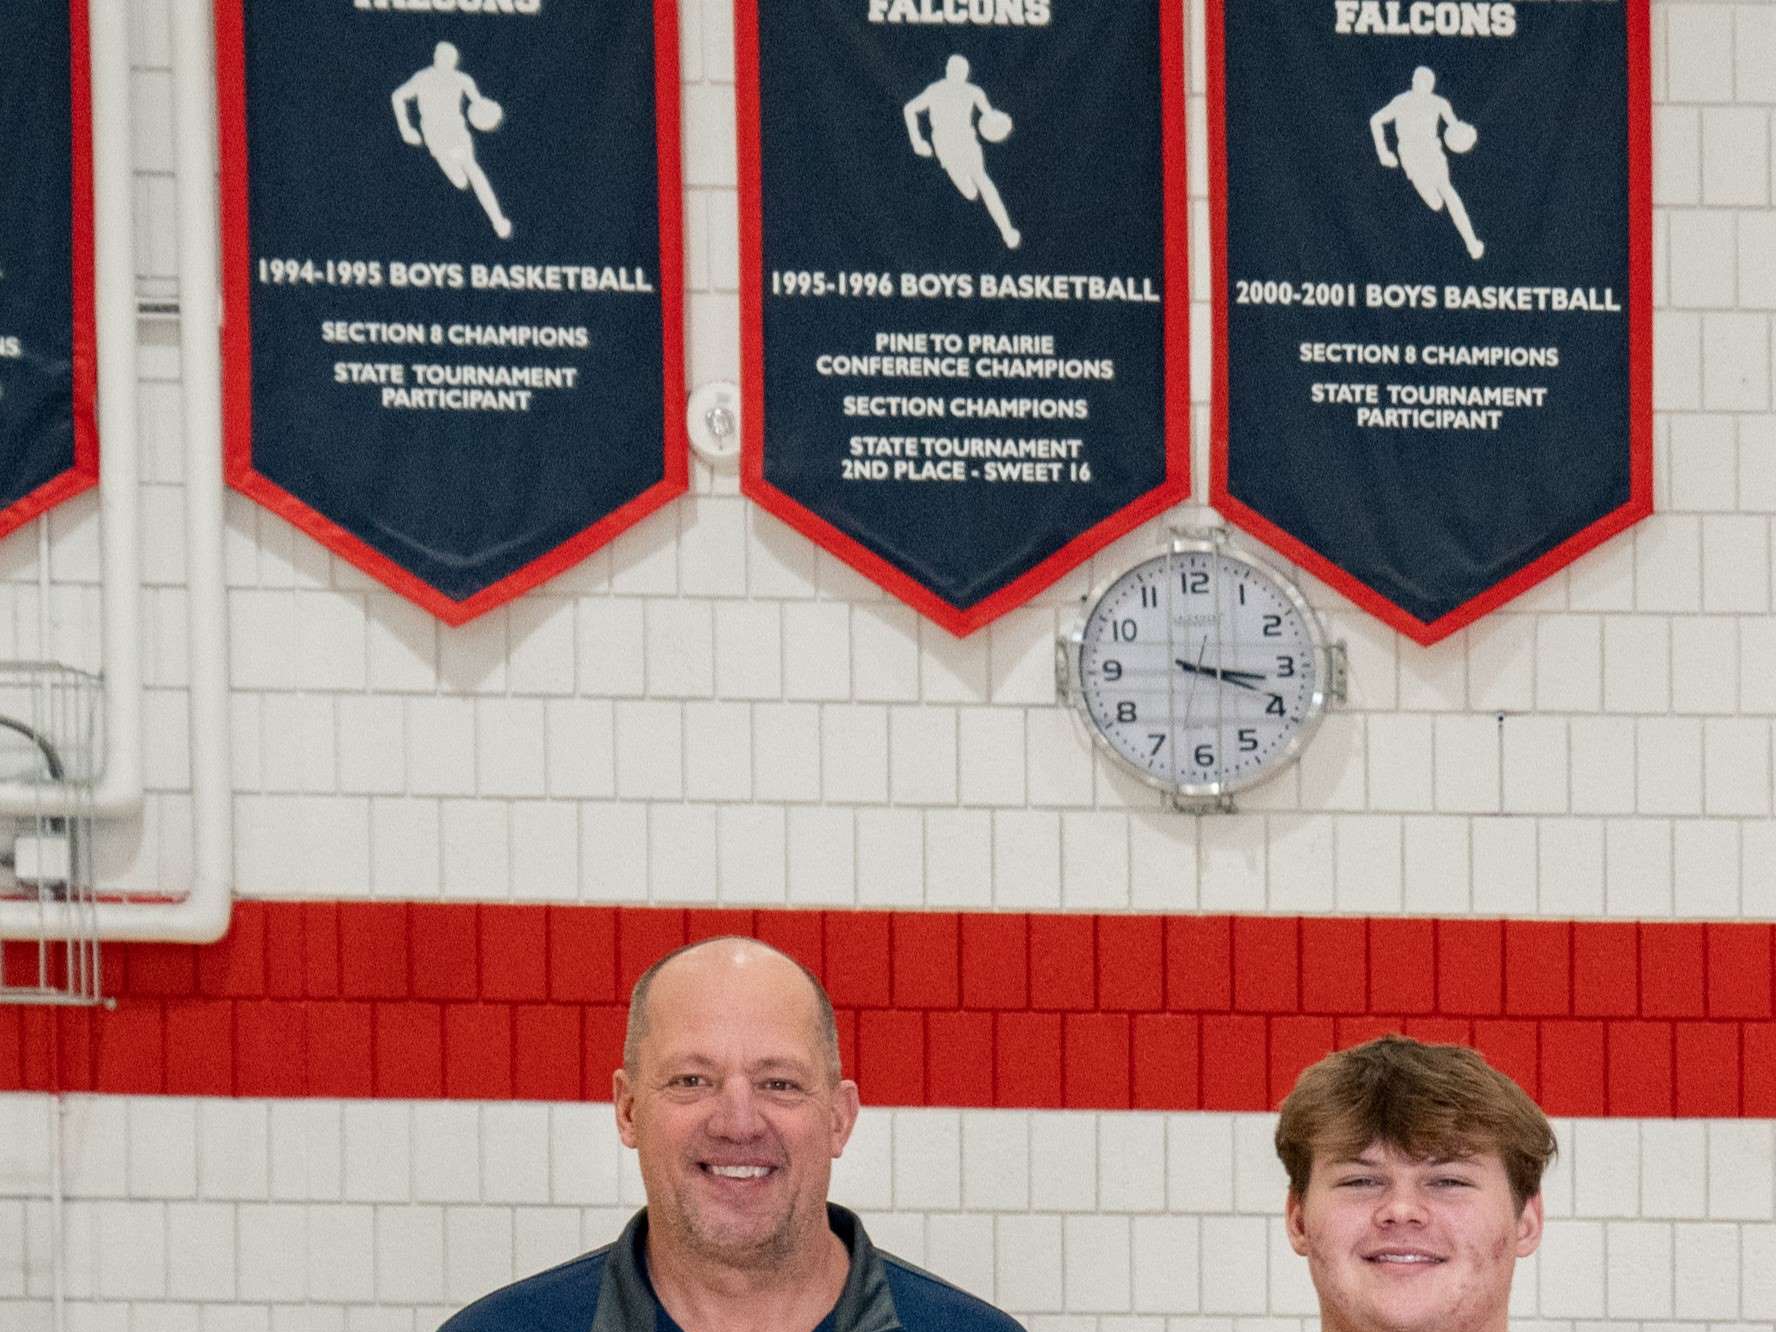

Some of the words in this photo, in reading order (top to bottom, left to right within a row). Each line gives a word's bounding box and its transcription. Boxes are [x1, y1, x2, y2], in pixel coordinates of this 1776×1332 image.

[867, 0, 1051, 25] FALCONS
[1334, 0, 1517, 37] FALCONS
[257, 259, 383, 286] 1994-1995
[388, 261, 464, 289] BOYS
[469, 264, 654, 294] BASKETBALL
[770, 271, 894, 298] 1995-1996
[900, 273, 974, 299] BOYS
[980, 274, 1160, 303] BASKETBALL
[1235, 281, 1359, 308] 2000-2001
[1365, 283, 1439, 309] BOYS
[1443, 285, 1622, 313] BASKETBALL
[321, 322, 423, 345] SECTION
[427, 324, 443, 345] 8
[446, 325, 589, 349] CHAMPIONS
[874, 333, 924, 355] PINE
[922, 333, 961, 355] TO
[967, 333, 1055, 356] PRAIRIE
[1299, 343, 1401, 366] SECTION
[1404, 344, 1418, 366] 8
[1421, 344, 1560, 368] CHAMPIONS
[334, 362, 405, 385] STATE
[412, 364, 578, 389] TOURNAMENT
[815, 356, 972, 379] CONFERENCE
[974, 357, 1115, 381] CHAMPIONS
[381, 388, 531, 412] PARTICIPANT
[1310, 382, 1380, 405] STATE
[1386, 385, 1548, 408] TOURNAMENT
[842, 396, 945, 418] SECTION
[949, 397, 1089, 420] CHAMPIONS
[1356, 407, 1503, 431] PARTICIPANT
[849, 435, 916, 458] STATE
[916, 436, 1082, 460] TOURNAMENT
[841, 459, 890, 481] 2ND
[893, 459, 967, 481] PLACE
[983, 461, 1063, 482] SWEET
[1068, 462, 1092, 482] 16
[1180, 572, 1210, 595] 12
[1238, 584, 1246, 606] 1
[1141, 586, 1157, 608] 11
[1113, 618, 1138, 643] 10
[1262, 614, 1283, 637] 2
[1102, 660, 1123, 682] 9
[1276, 655, 1296, 678] 3
[1117, 701, 1138, 724] 8
[1264, 694, 1287, 718] 4
[1147, 734, 1167, 757] 7
[1238, 729, 1259, 752] 5
[1194, 745, 1215, 768] 6
